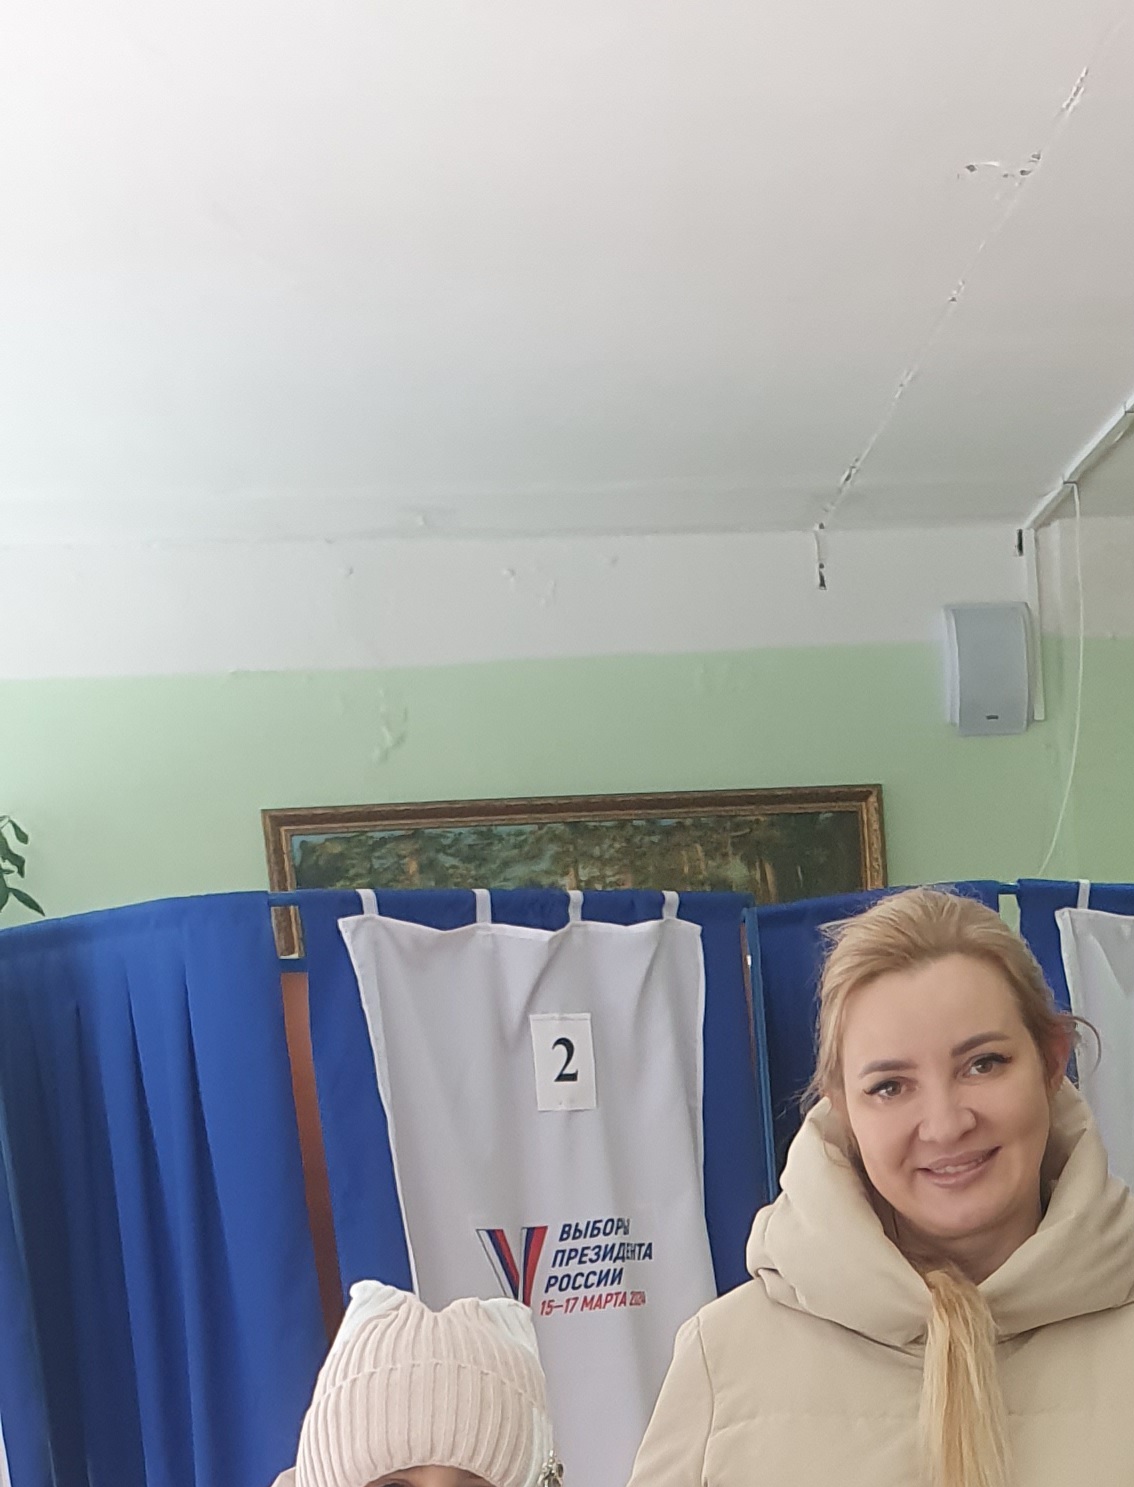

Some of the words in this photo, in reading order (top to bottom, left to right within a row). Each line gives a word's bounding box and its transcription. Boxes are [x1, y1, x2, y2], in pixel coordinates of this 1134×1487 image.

[552, 1037, 579, 1083] 2
[558, 1217, 631, 1243] ВЫБОРЫ
[551, 1242, 653, 1268] ПРЕЗИДЕНТА
[544, 1267, 624, 1294] РОССИИ
[580, 1291, 628, 1312] МАРТА
